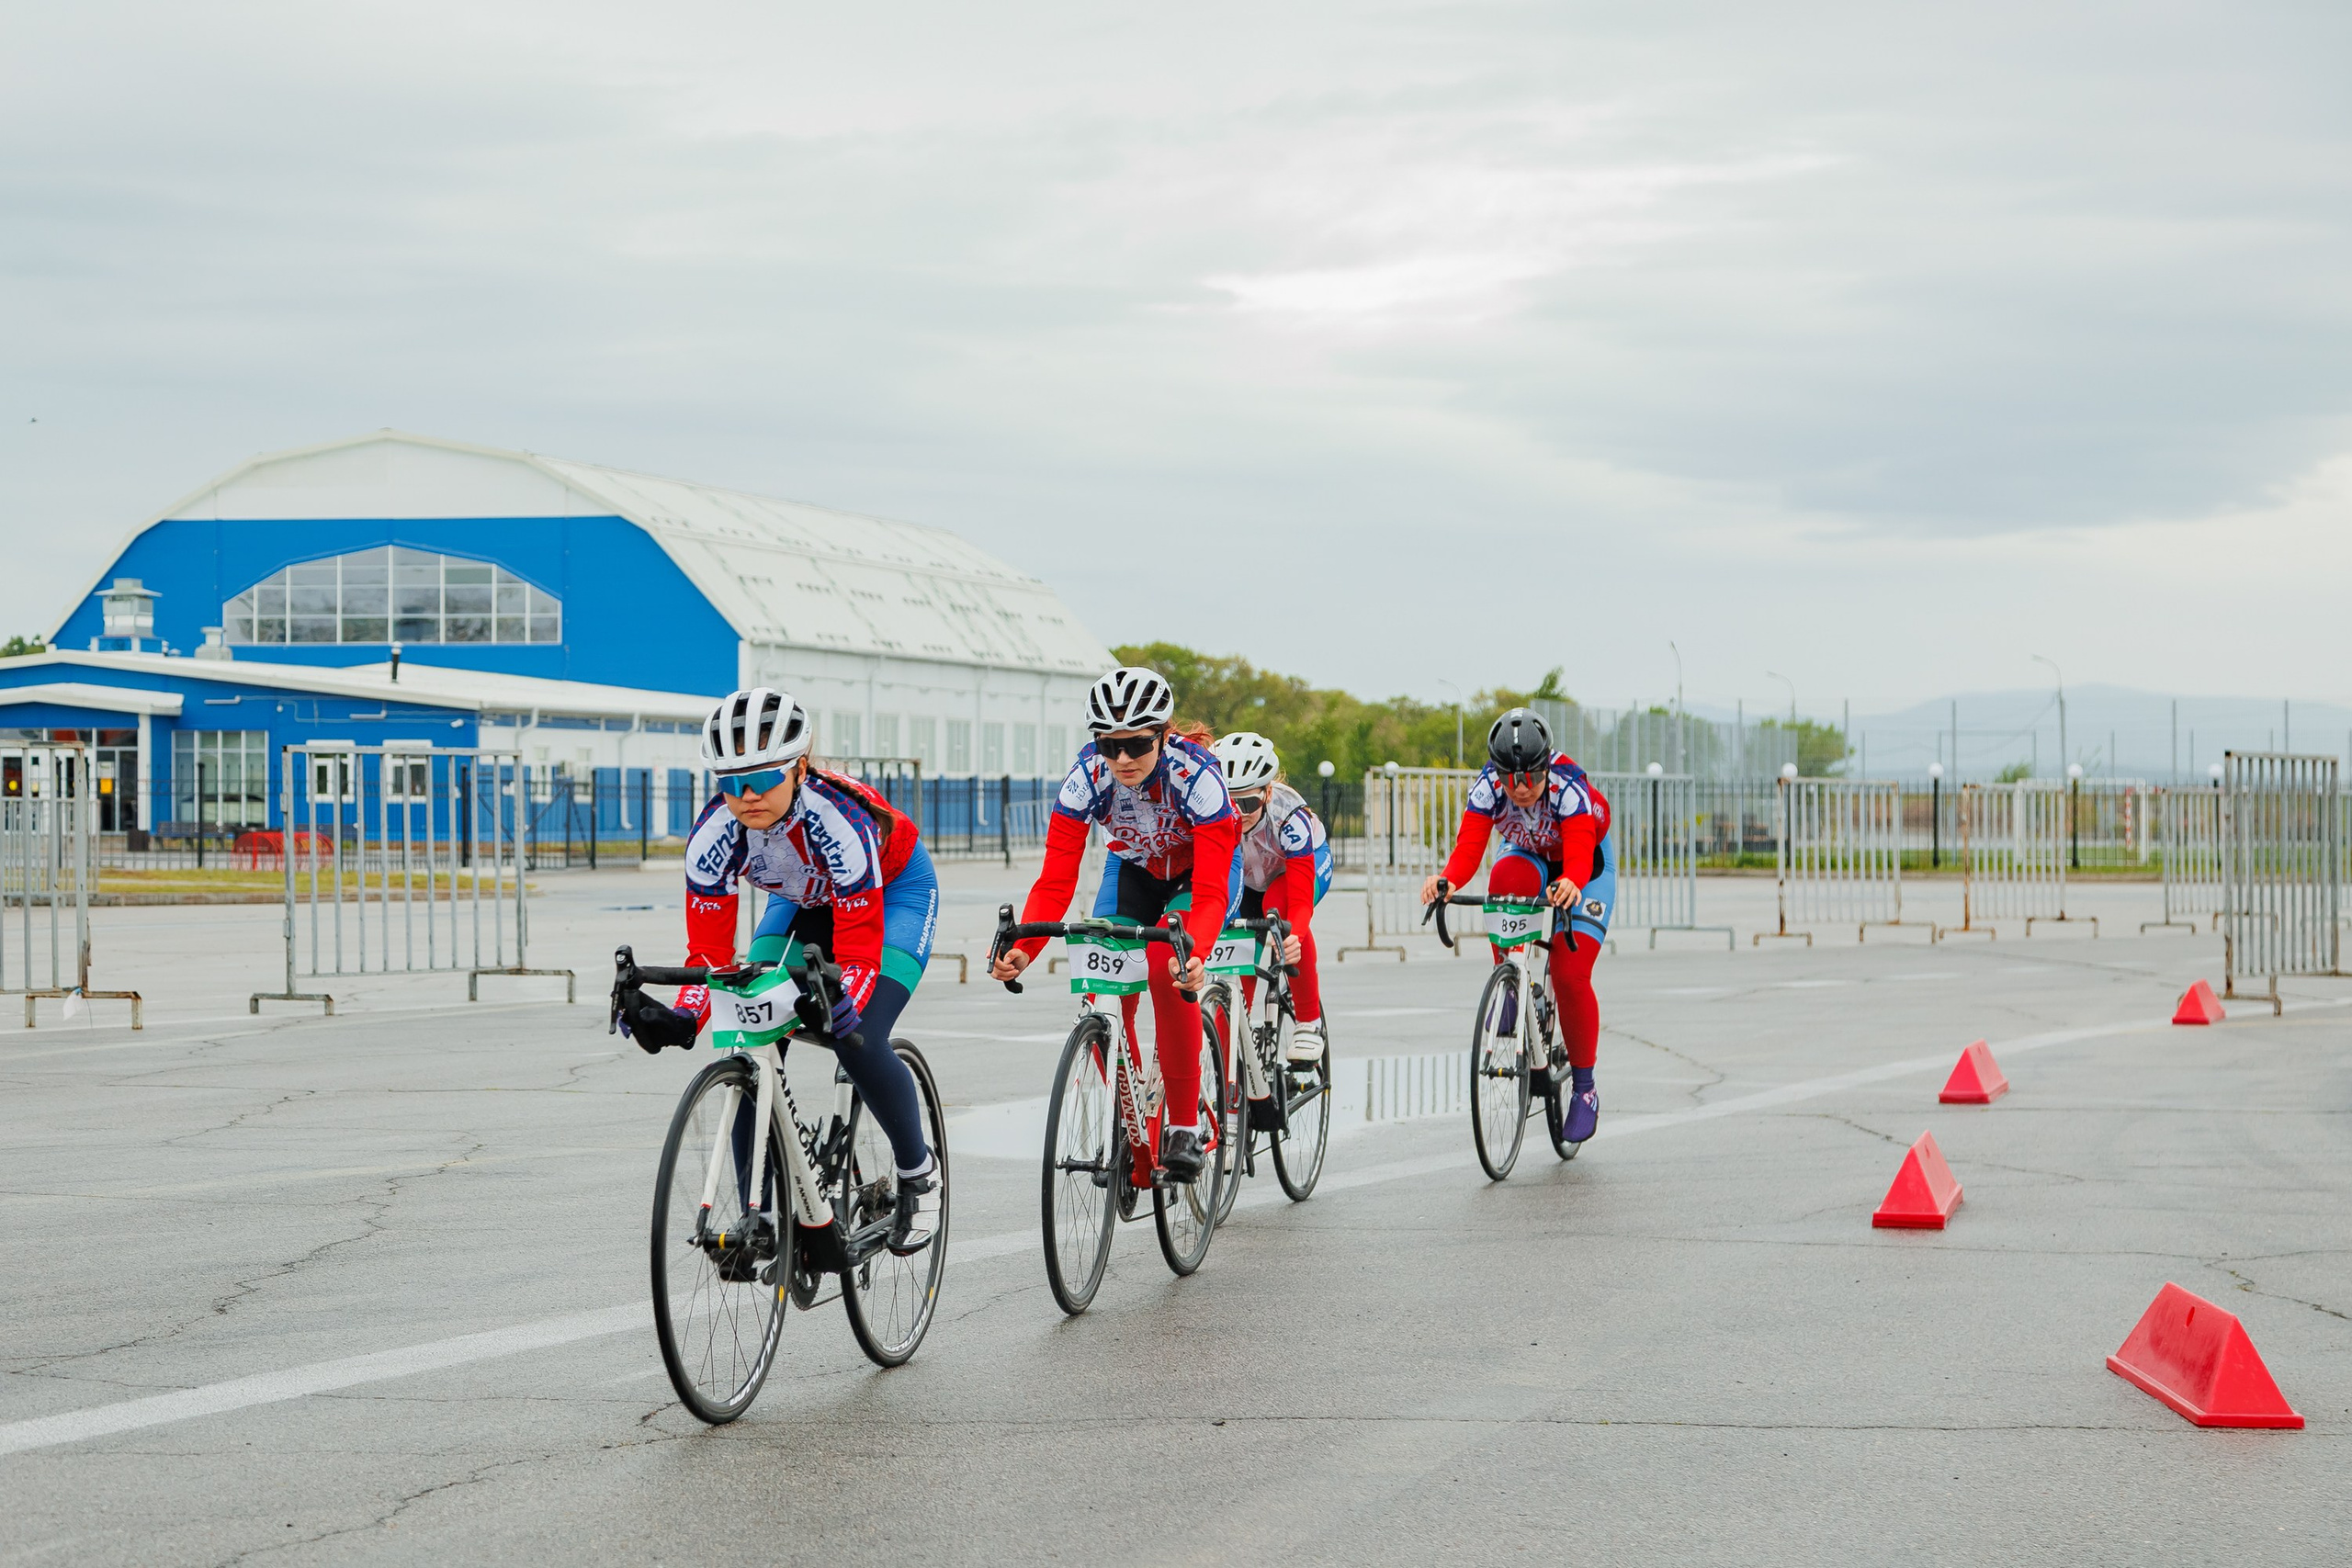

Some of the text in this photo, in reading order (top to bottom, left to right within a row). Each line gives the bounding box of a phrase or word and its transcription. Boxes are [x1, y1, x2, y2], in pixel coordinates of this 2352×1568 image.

[691, 897, 721, 914] Русь
[916, 888, 937, 956] ХАБАРОВСКИЙ
[1502, 919, 1527, 933] 895
[1087, 952, 1124, 975] 859
[735, 1001, 773, 1024] 857
[1117, 1070, 1142, 1147] COLNAGO
